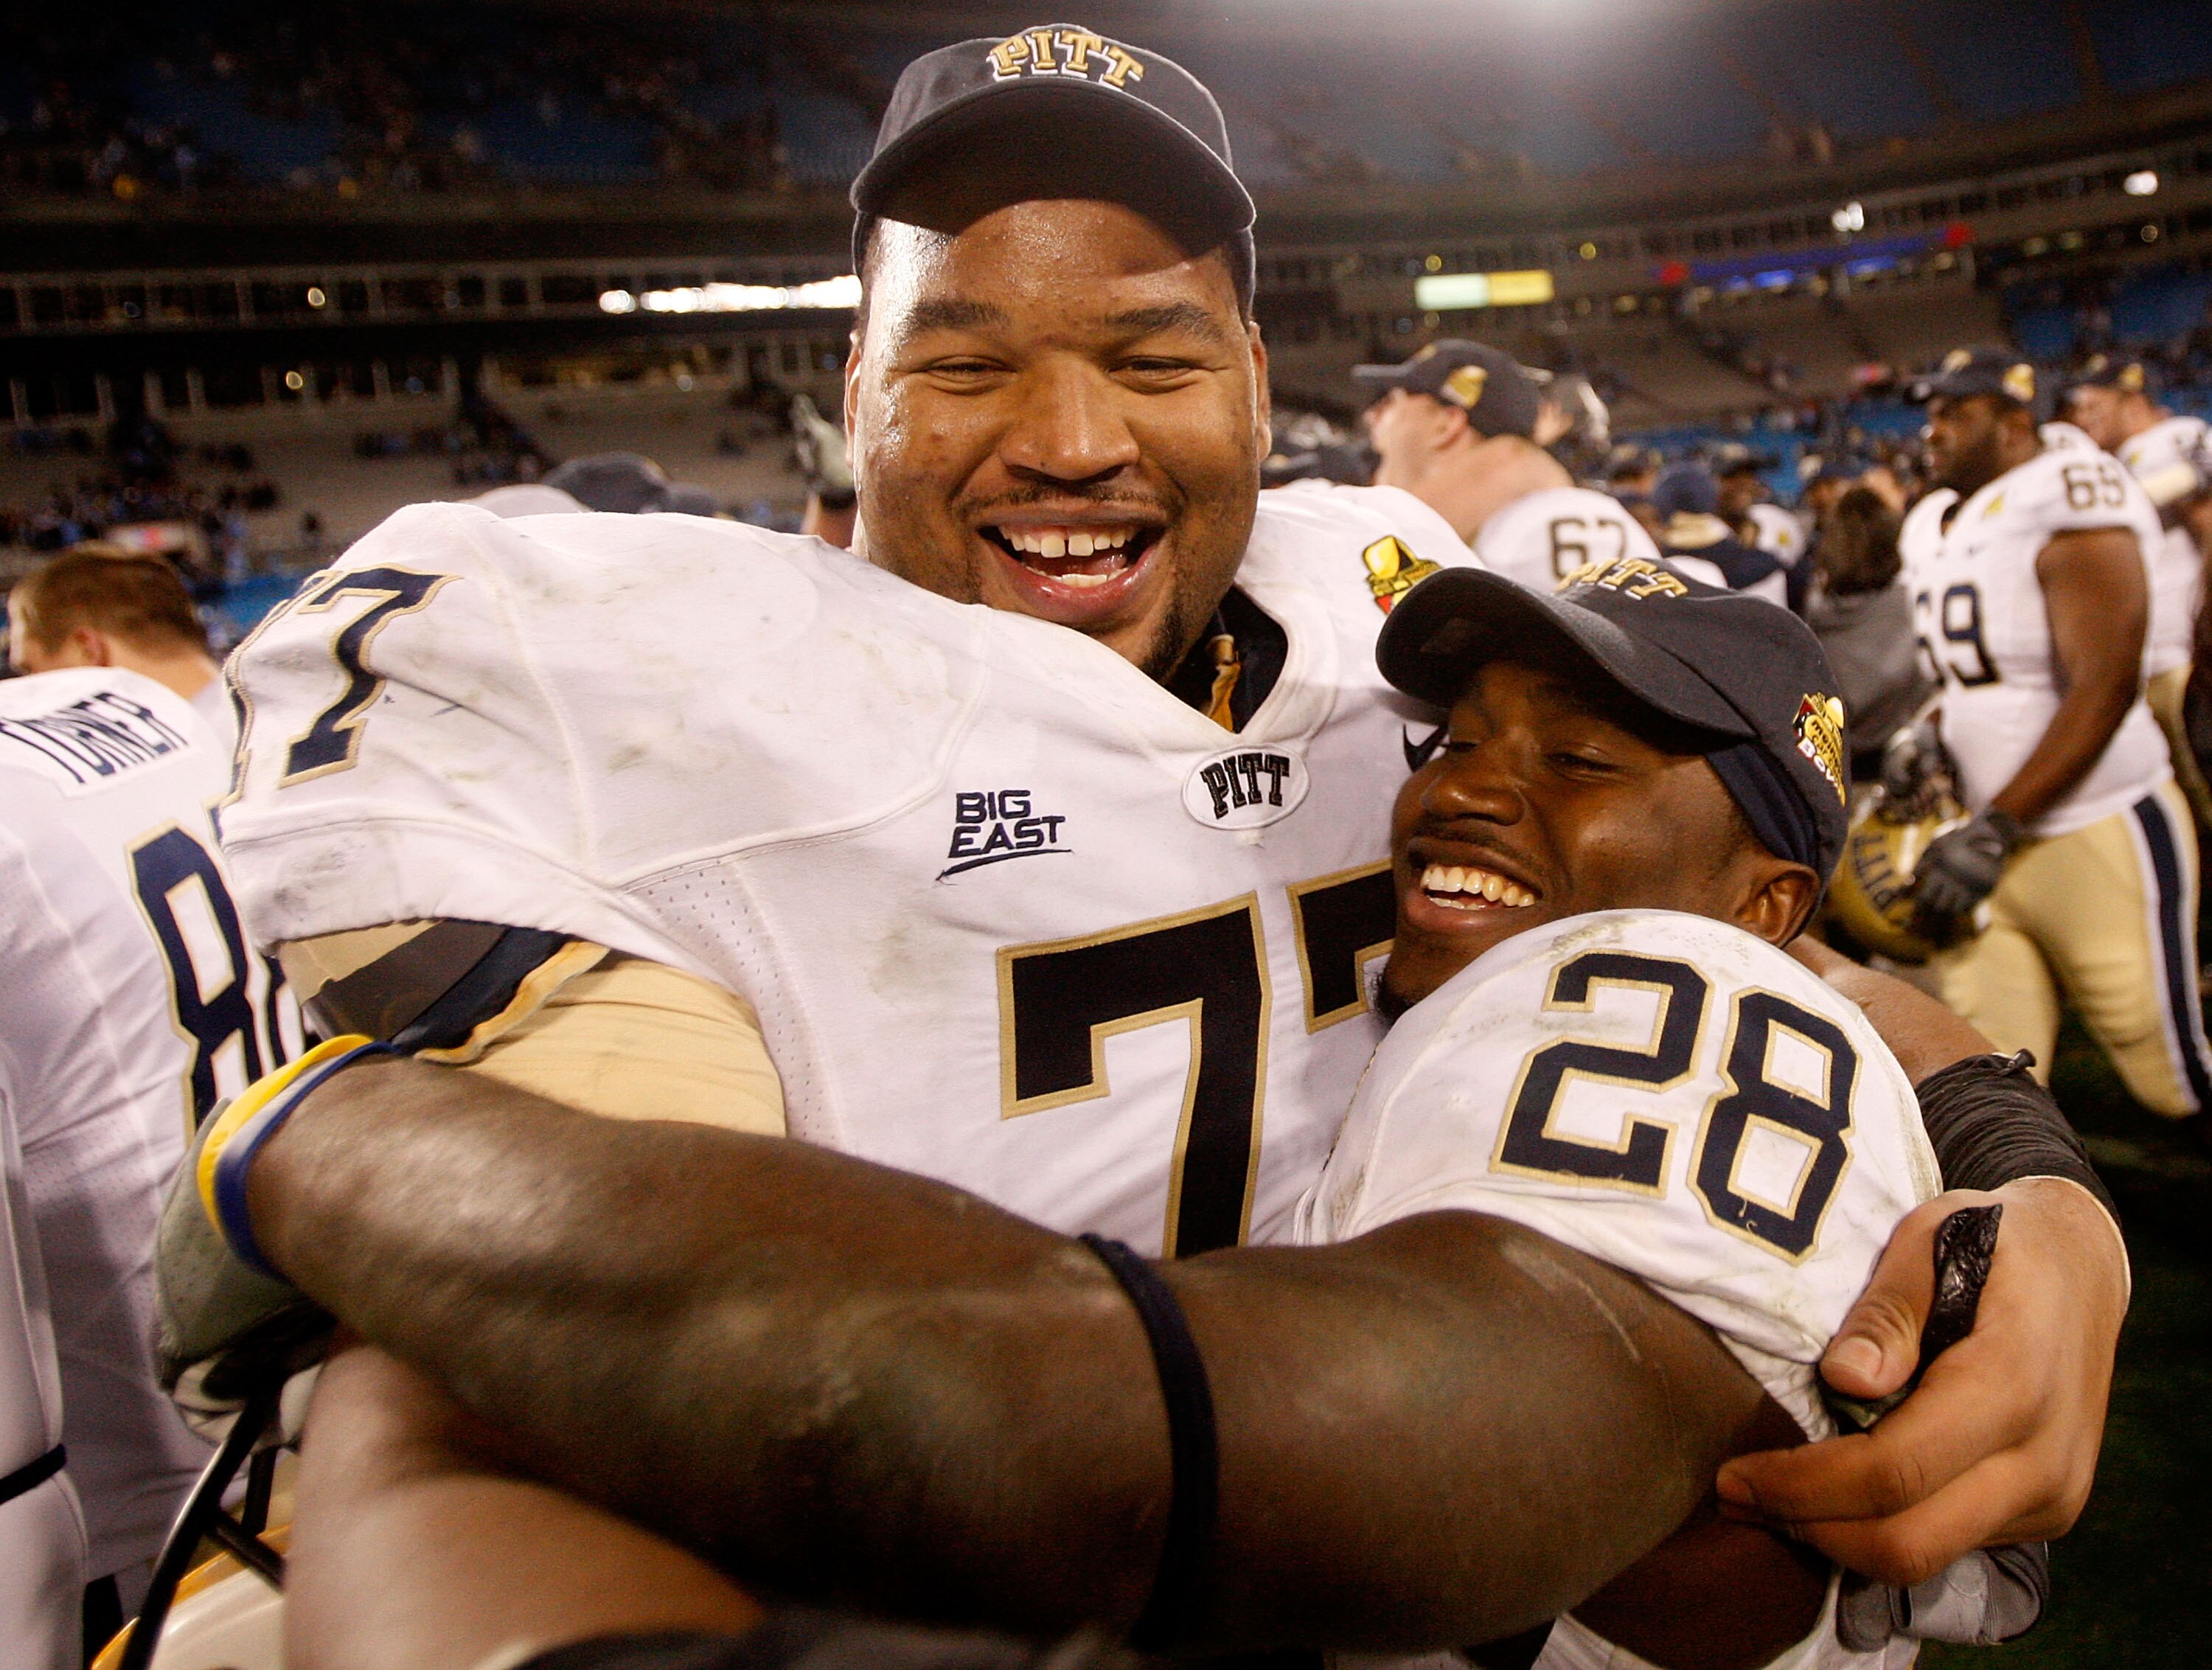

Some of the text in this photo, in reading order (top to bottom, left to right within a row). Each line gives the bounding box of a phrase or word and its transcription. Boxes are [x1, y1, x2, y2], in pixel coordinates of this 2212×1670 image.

[986, 29, 1144, 91] PITT
[221, 563, 463, 805] 7
[956, 790, 1031, 824] BIG
[1201, 752, 1290, 819] PITT
[948, 816, 1065, 858] EAST
[124, 801, 289, 1150] 8
[1489, 948, 1863, 1267] 28
